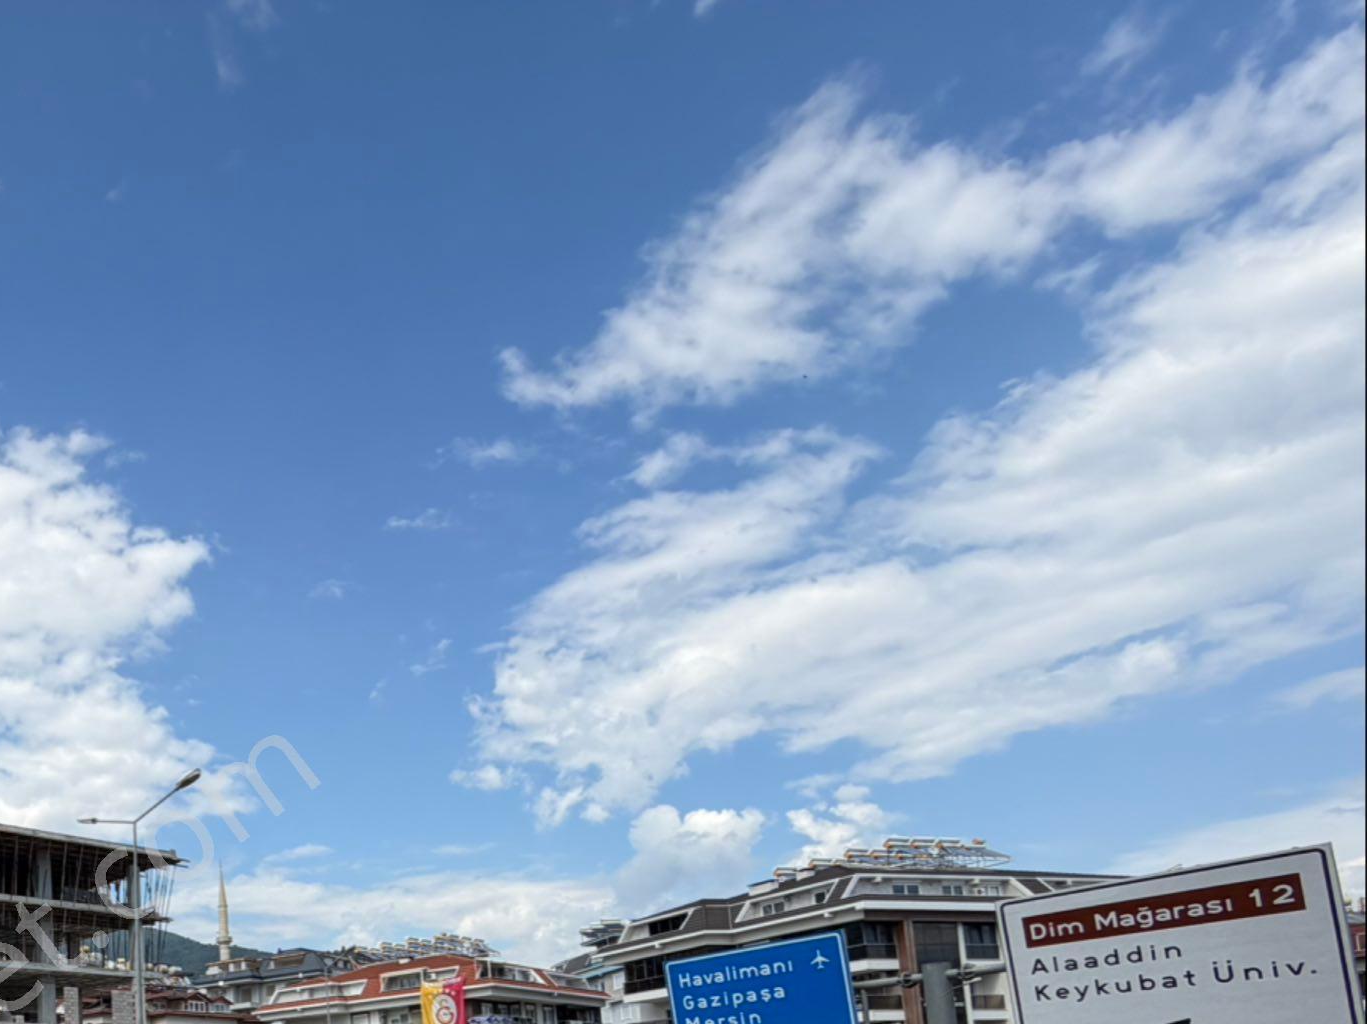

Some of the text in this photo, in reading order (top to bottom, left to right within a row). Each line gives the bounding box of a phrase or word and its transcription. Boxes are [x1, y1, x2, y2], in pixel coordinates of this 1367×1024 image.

[1029, 921, 1084, 941] Dim
[1094, 898, 1233, 929] Mağarası
[678, 960, 794, 988] Havalimanı
[1031, 945, 1182, 975] Alaaddin
[1035, 960, 1318, 1002] Keykubat Üniv.
[683, 986, 786, 1010] Gazipaşa
